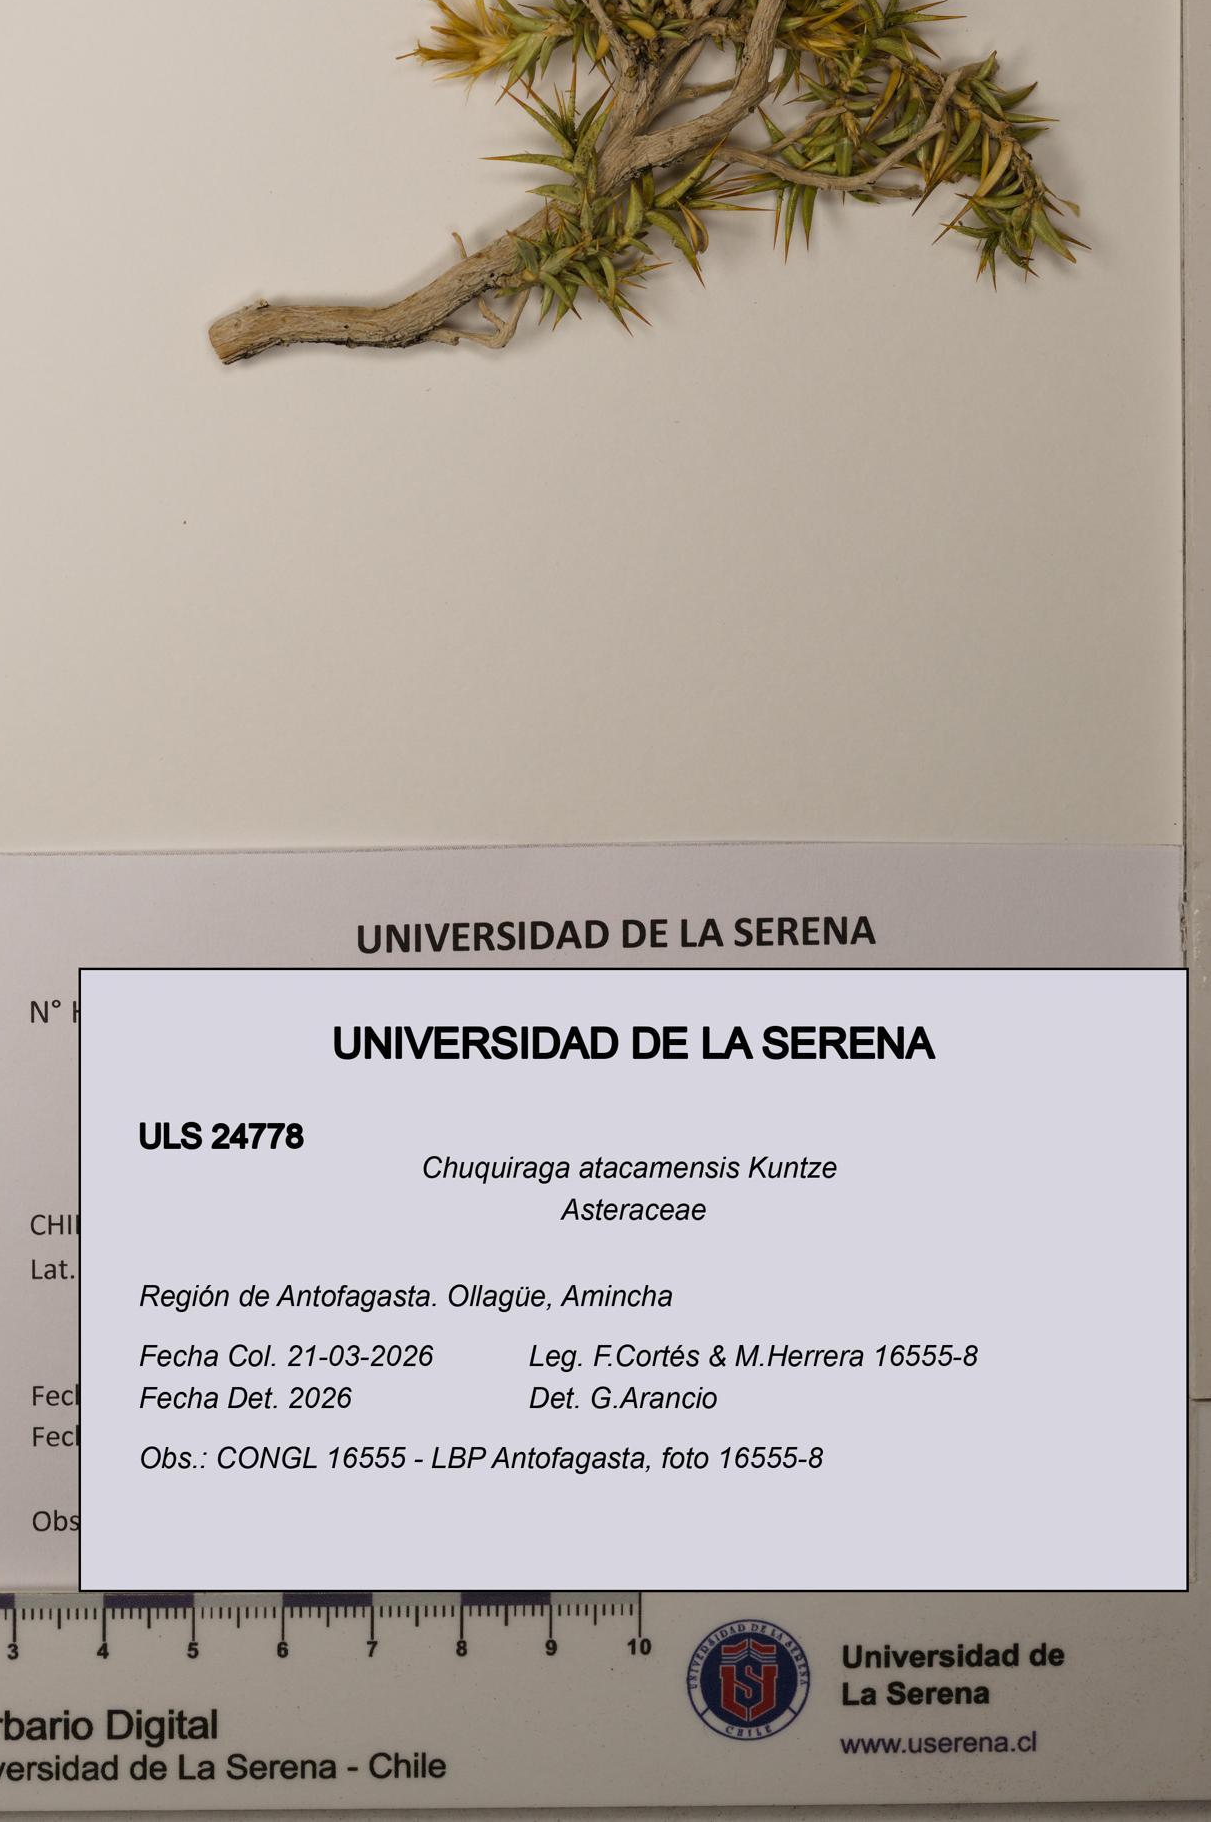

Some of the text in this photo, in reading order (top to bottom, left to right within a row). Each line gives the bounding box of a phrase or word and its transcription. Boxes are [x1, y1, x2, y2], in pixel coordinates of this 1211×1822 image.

[357, 915, 877, 955] UNIVERSIDAD DE LA SERENA
[31, 1258, 76, 1281] Lat.
[7, 1643, 19, 1661] 3
[96, 1642, 110, 1660] 4
[186, 1642, 200, 1660] 5
[276, 1641, 289, 1659] 6
[366, 1640, 379, 1658] 7
[455, 1640, 468, 1658] 8
[544, 1639, 558, 1657] 9
[626, 1638, 652, 1656] 10
[688, 1623, 746, 1690] UNIVERSIDAD
[842, 1642, 1065, 1670] Universidad de
[842, 1680, 990, 1706] La Serena
[106, 1708, 218, 1748] Digital
[725, 1724, 773, 1738] CHILE
[839, 1730, 1037, 1755] www.userena.cl
[129, 1753, 168, 1781] de
[178, 1753, 216, 1781] La
[226, 1753, 337, 1781] Serena
[368, 1751, 447, 1780] Chile
